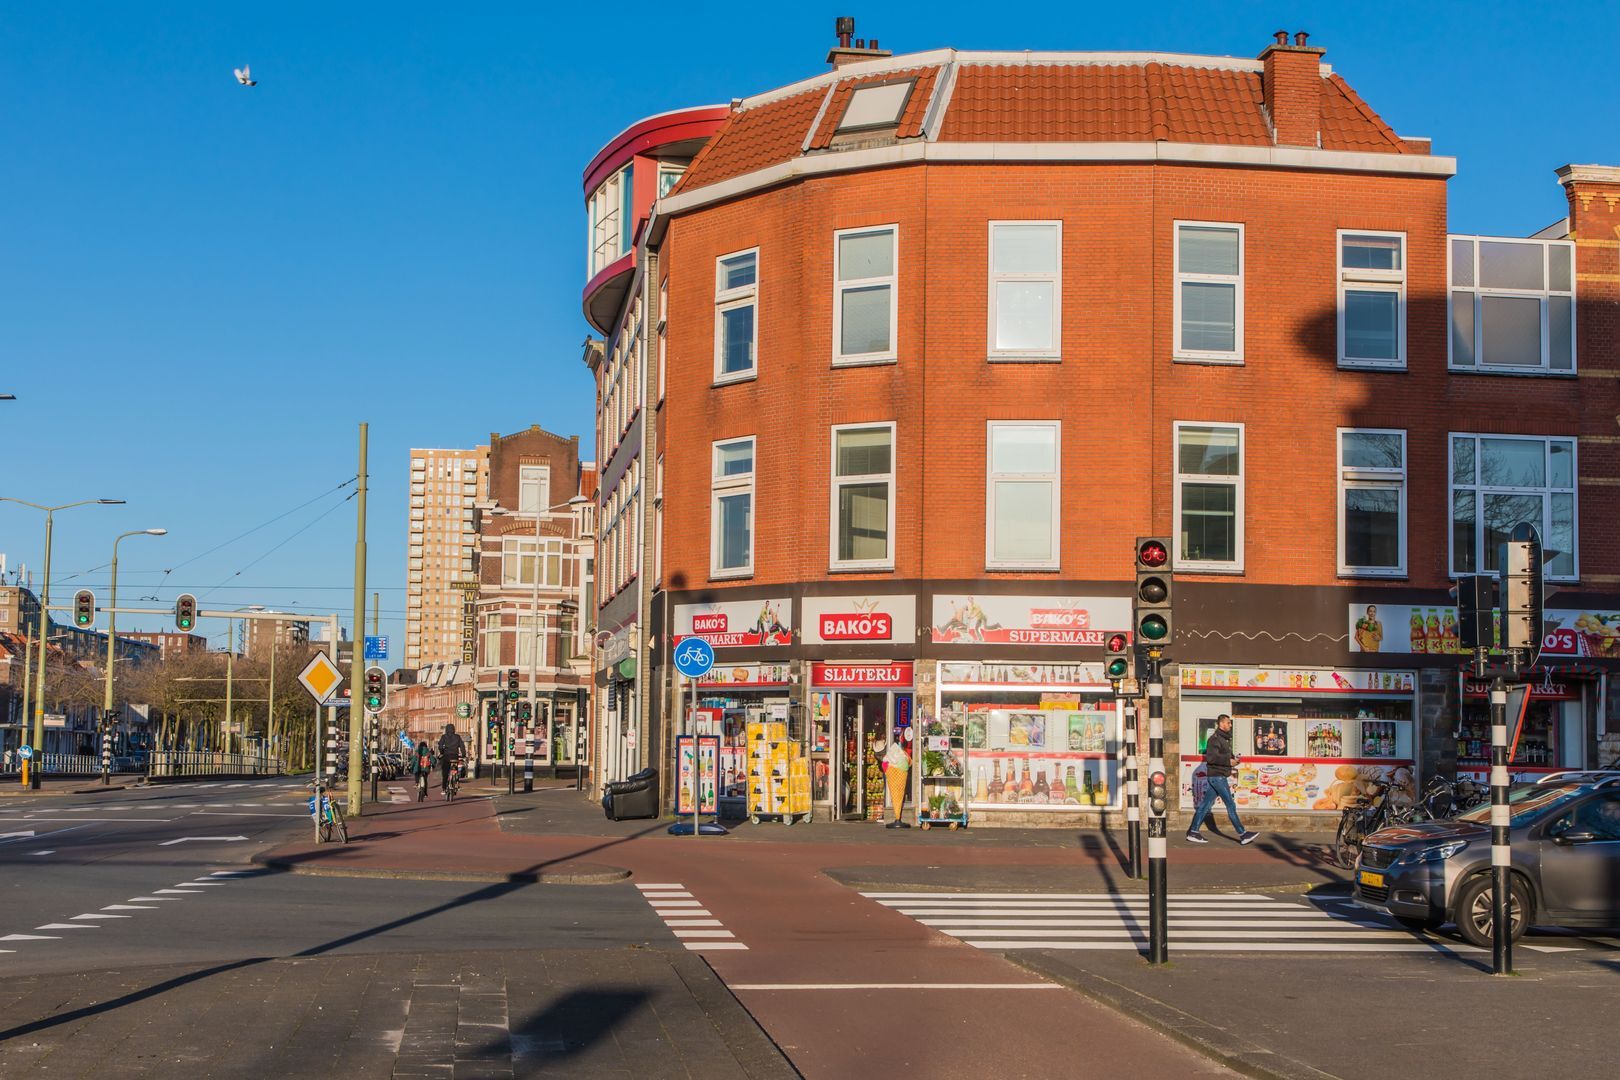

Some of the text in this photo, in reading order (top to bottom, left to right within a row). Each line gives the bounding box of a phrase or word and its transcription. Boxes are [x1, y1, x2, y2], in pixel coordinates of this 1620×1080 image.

[694, 618, 726, 630] BAKO'S
[1031, 613, 1086, 625] BAKO'S
[464, 591, 474, 663] WIERAB
[824, 619, 887, 635] BAKO'S
[824, 668, 901, 681] SLIJTERIJ
